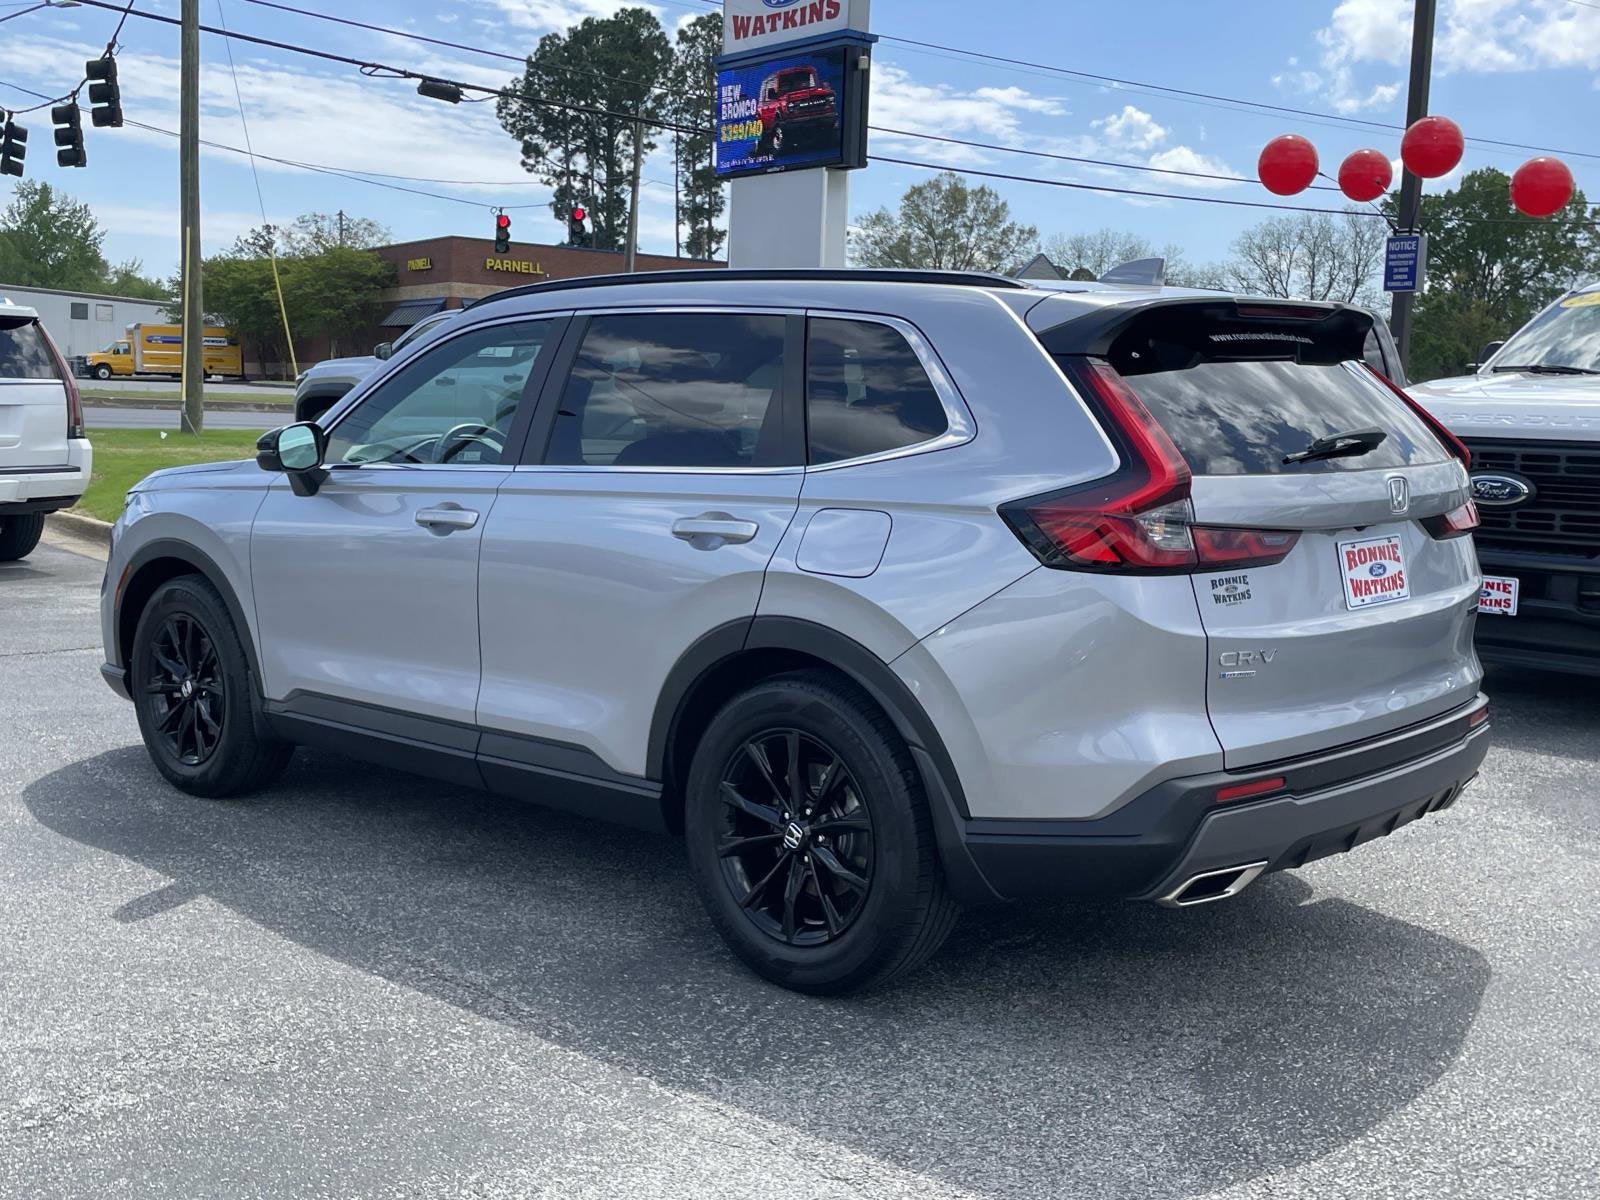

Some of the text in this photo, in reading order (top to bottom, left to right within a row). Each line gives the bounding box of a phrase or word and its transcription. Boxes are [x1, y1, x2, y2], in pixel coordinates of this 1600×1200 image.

[732, 0, 842, 41] WATKINS
[721, 83, 742, 102] NEW
[721, 98, 758, 120] BRONCO
[1389, 241, 1417, 251] NOTICE
[407, 257, 432, 271] PARNELL
[486, 257, 545, 275] PARNELL
[1476, 481, 1511, 497] Ford
[1345, 543, 1401, 572] RONNIE
[1210, 575, 1249, 590] RONNIE
[1349, 570, 1405, 598] WATKINS
[1481, 581, 1512, 595] NIE
[1213, 589, 1252, 604] WATKINS
[1478, 598, 1512, 609] KINS
